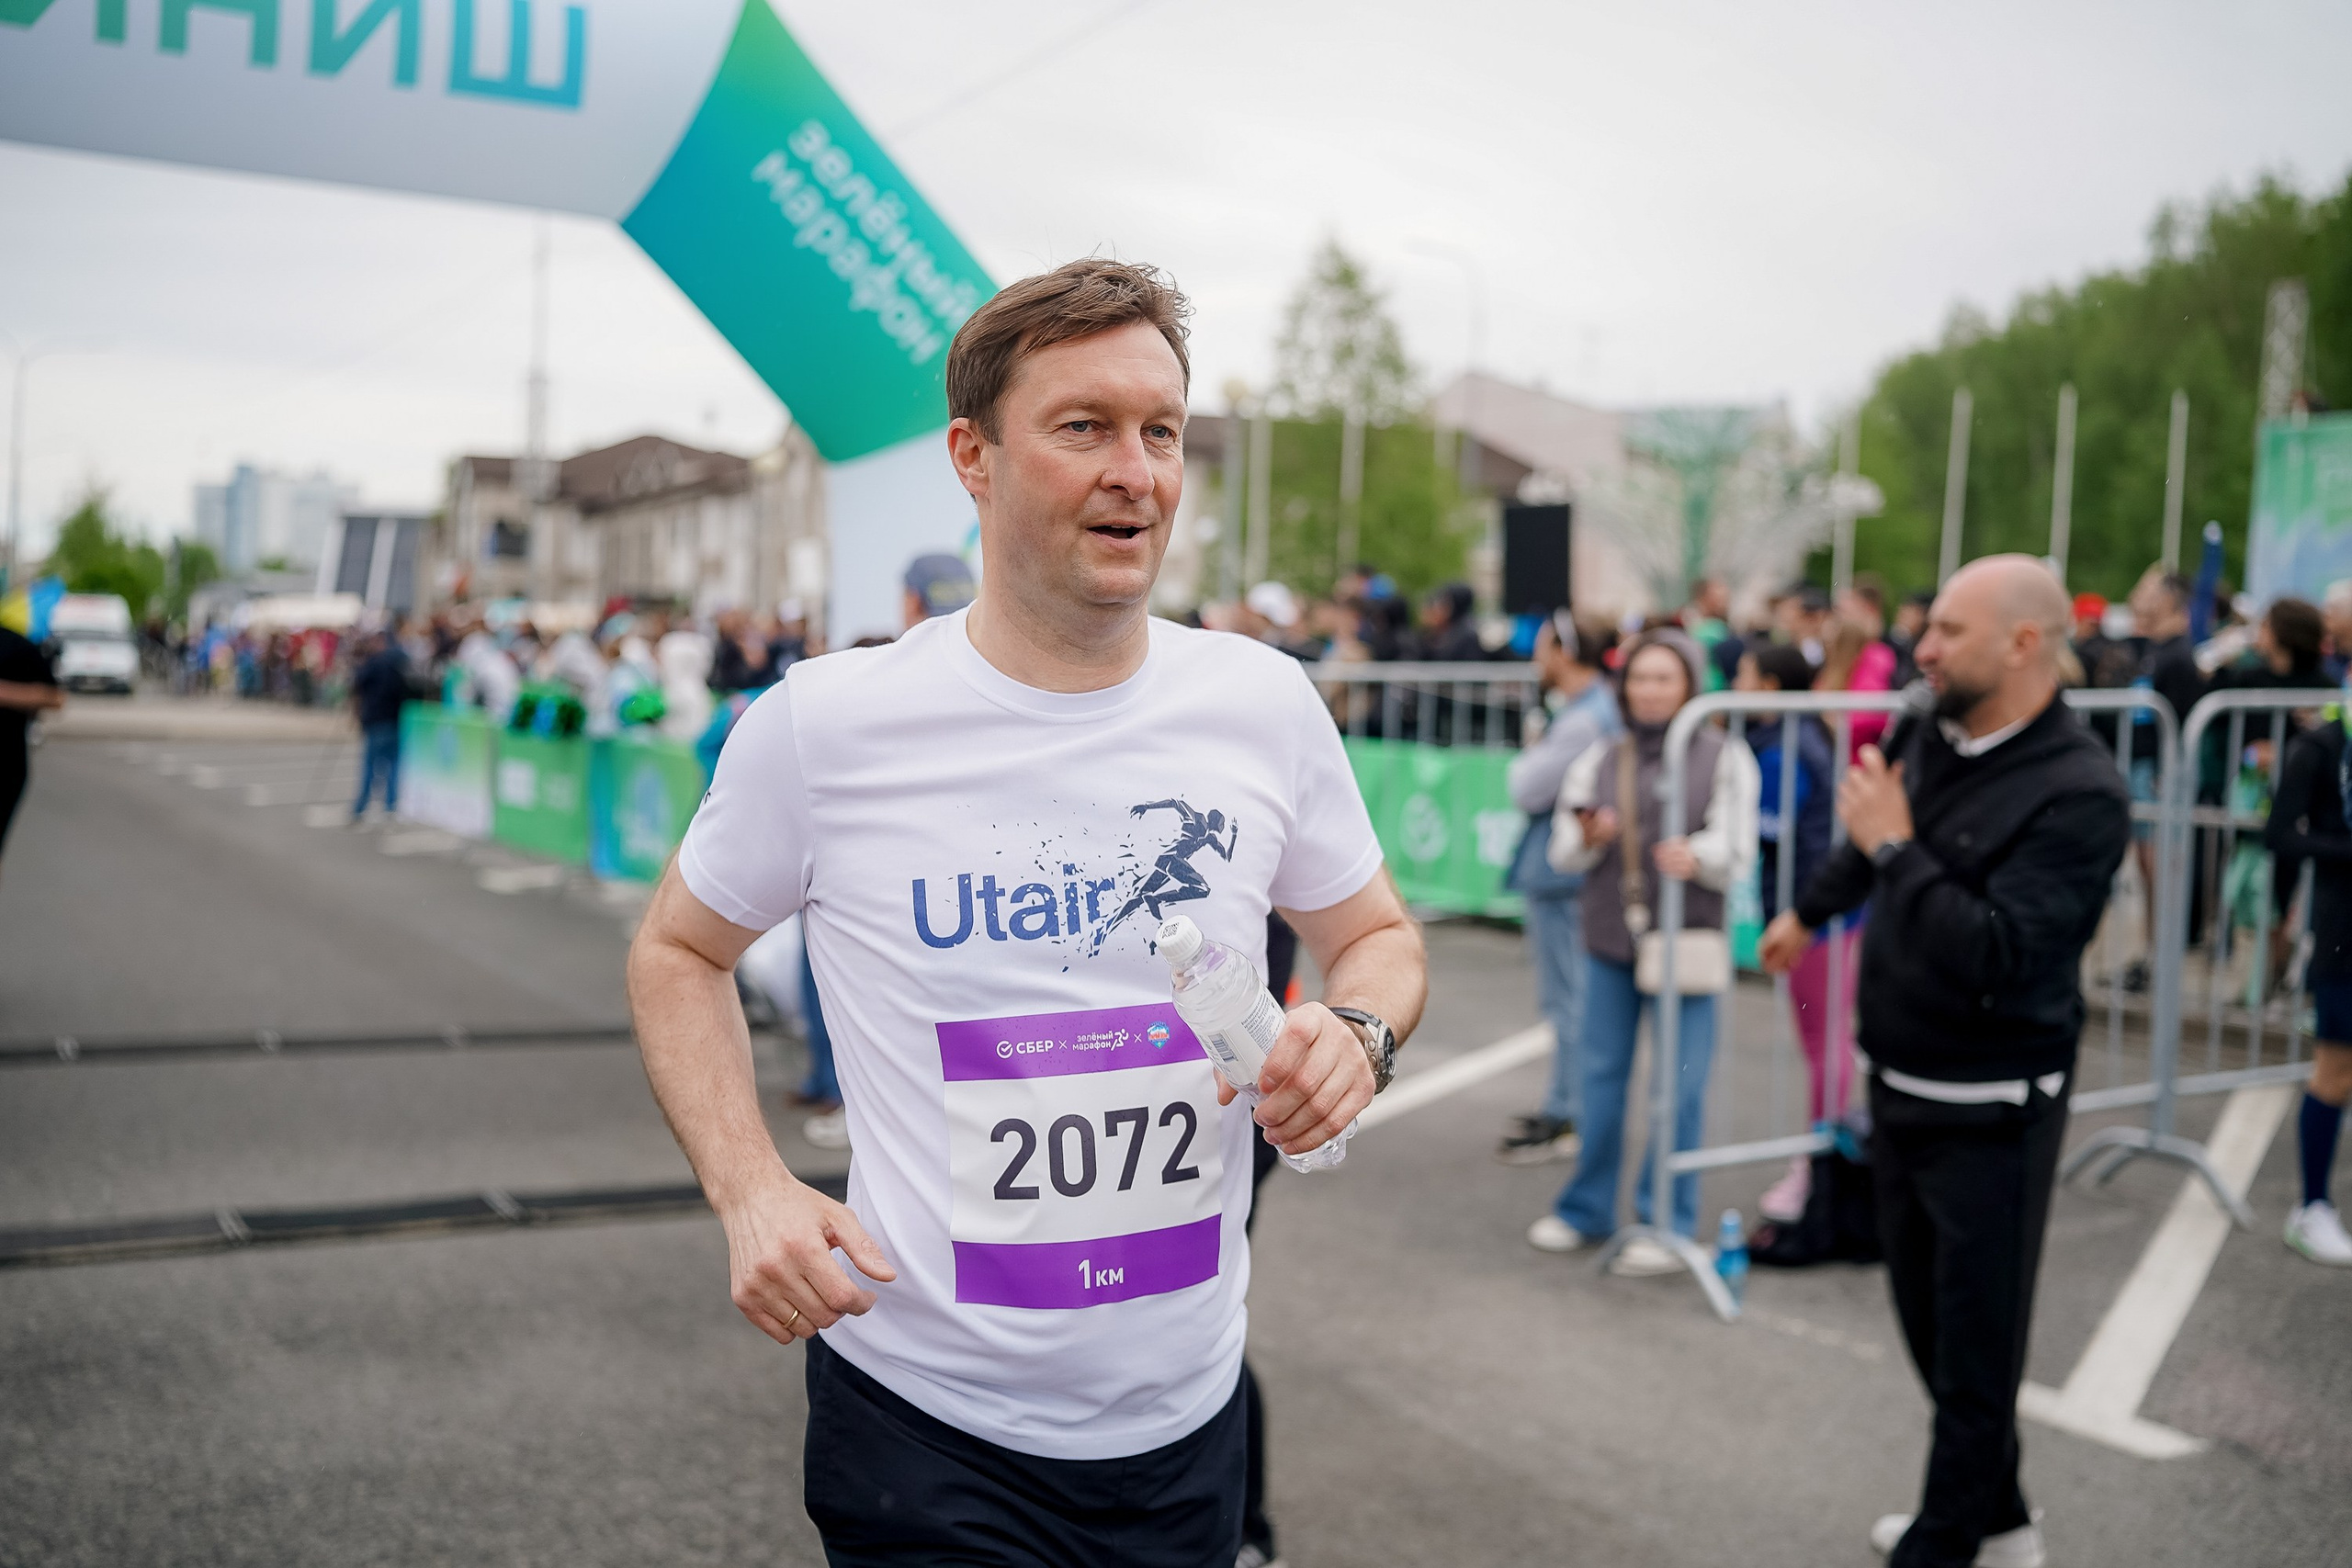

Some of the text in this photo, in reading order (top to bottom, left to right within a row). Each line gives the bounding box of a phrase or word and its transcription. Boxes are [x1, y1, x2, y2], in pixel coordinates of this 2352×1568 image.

[750, 149, 944, 366] марафон
[912, 863, 1115, 959] Utair
[1016, 1040, 1054, 1055] СБЕР
[1072, 1040, 1112, 1052] марафон
[1077, 1030, 1114, 1042] зелёный
[989, 1100, 1200, 1201] 2072
